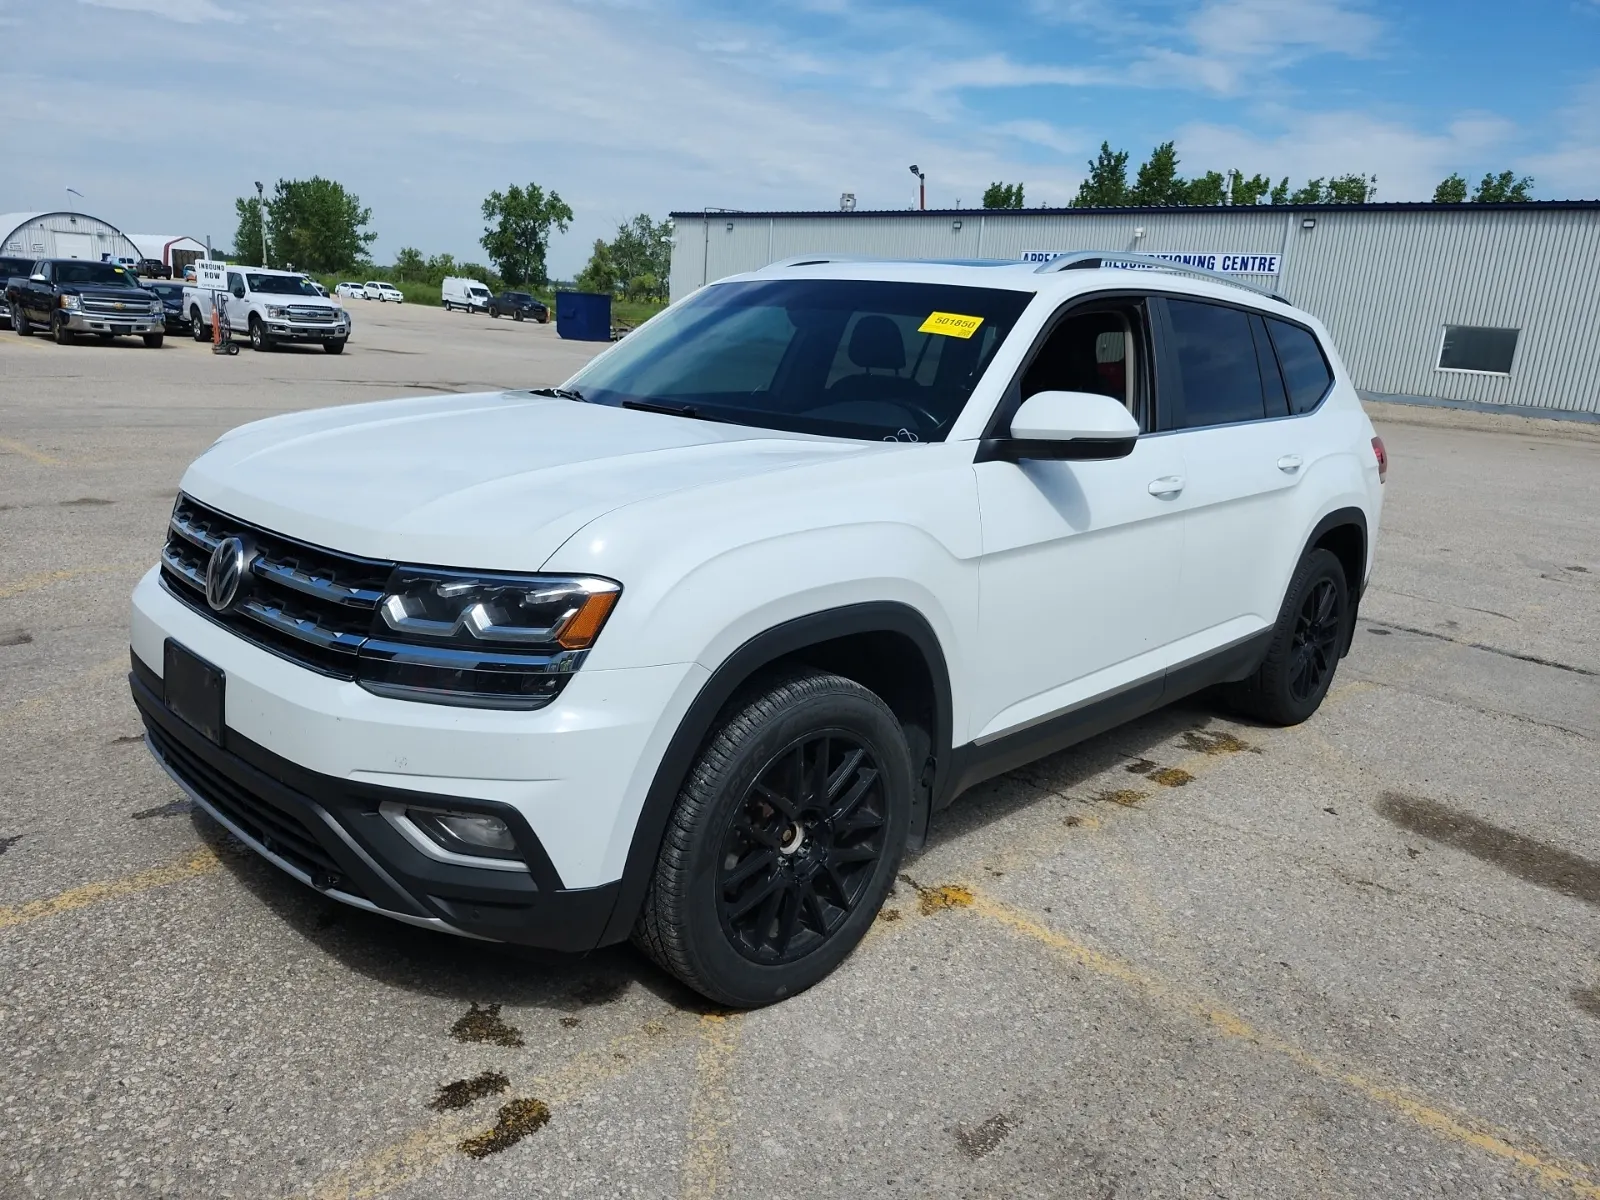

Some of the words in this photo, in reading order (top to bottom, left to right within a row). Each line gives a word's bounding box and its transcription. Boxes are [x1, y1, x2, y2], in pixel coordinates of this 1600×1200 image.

[198, 262, 225, 271] INBOUND
[1221, 255, 1277, 272] CENTRE
[204, 271, 221, 280] ROW
[934, 316, 977, 329] 501850
